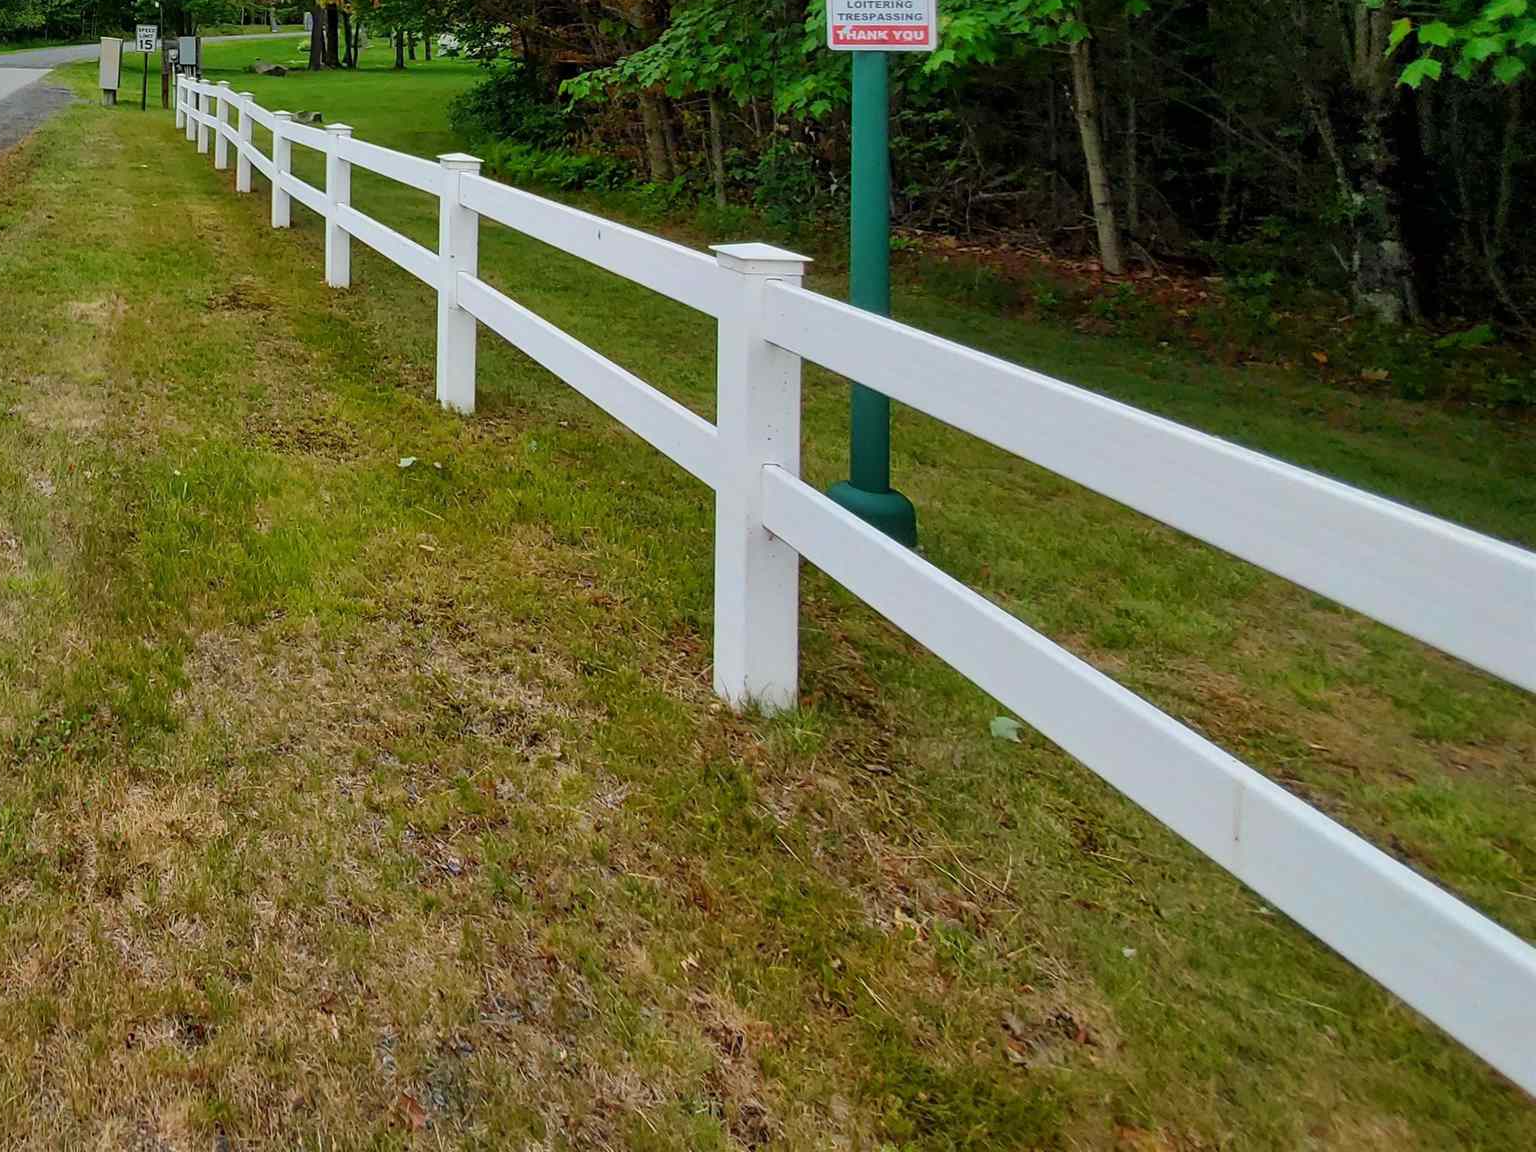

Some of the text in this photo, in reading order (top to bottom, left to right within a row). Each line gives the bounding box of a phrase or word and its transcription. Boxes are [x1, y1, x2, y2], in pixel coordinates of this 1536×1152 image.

[847, 0, 913, 9] LOITERING
[837, 12, 923, 21] TRESPASSING
[836, 30, 925, 41] THANK YOU
[140, 39, 153, 50] 15
